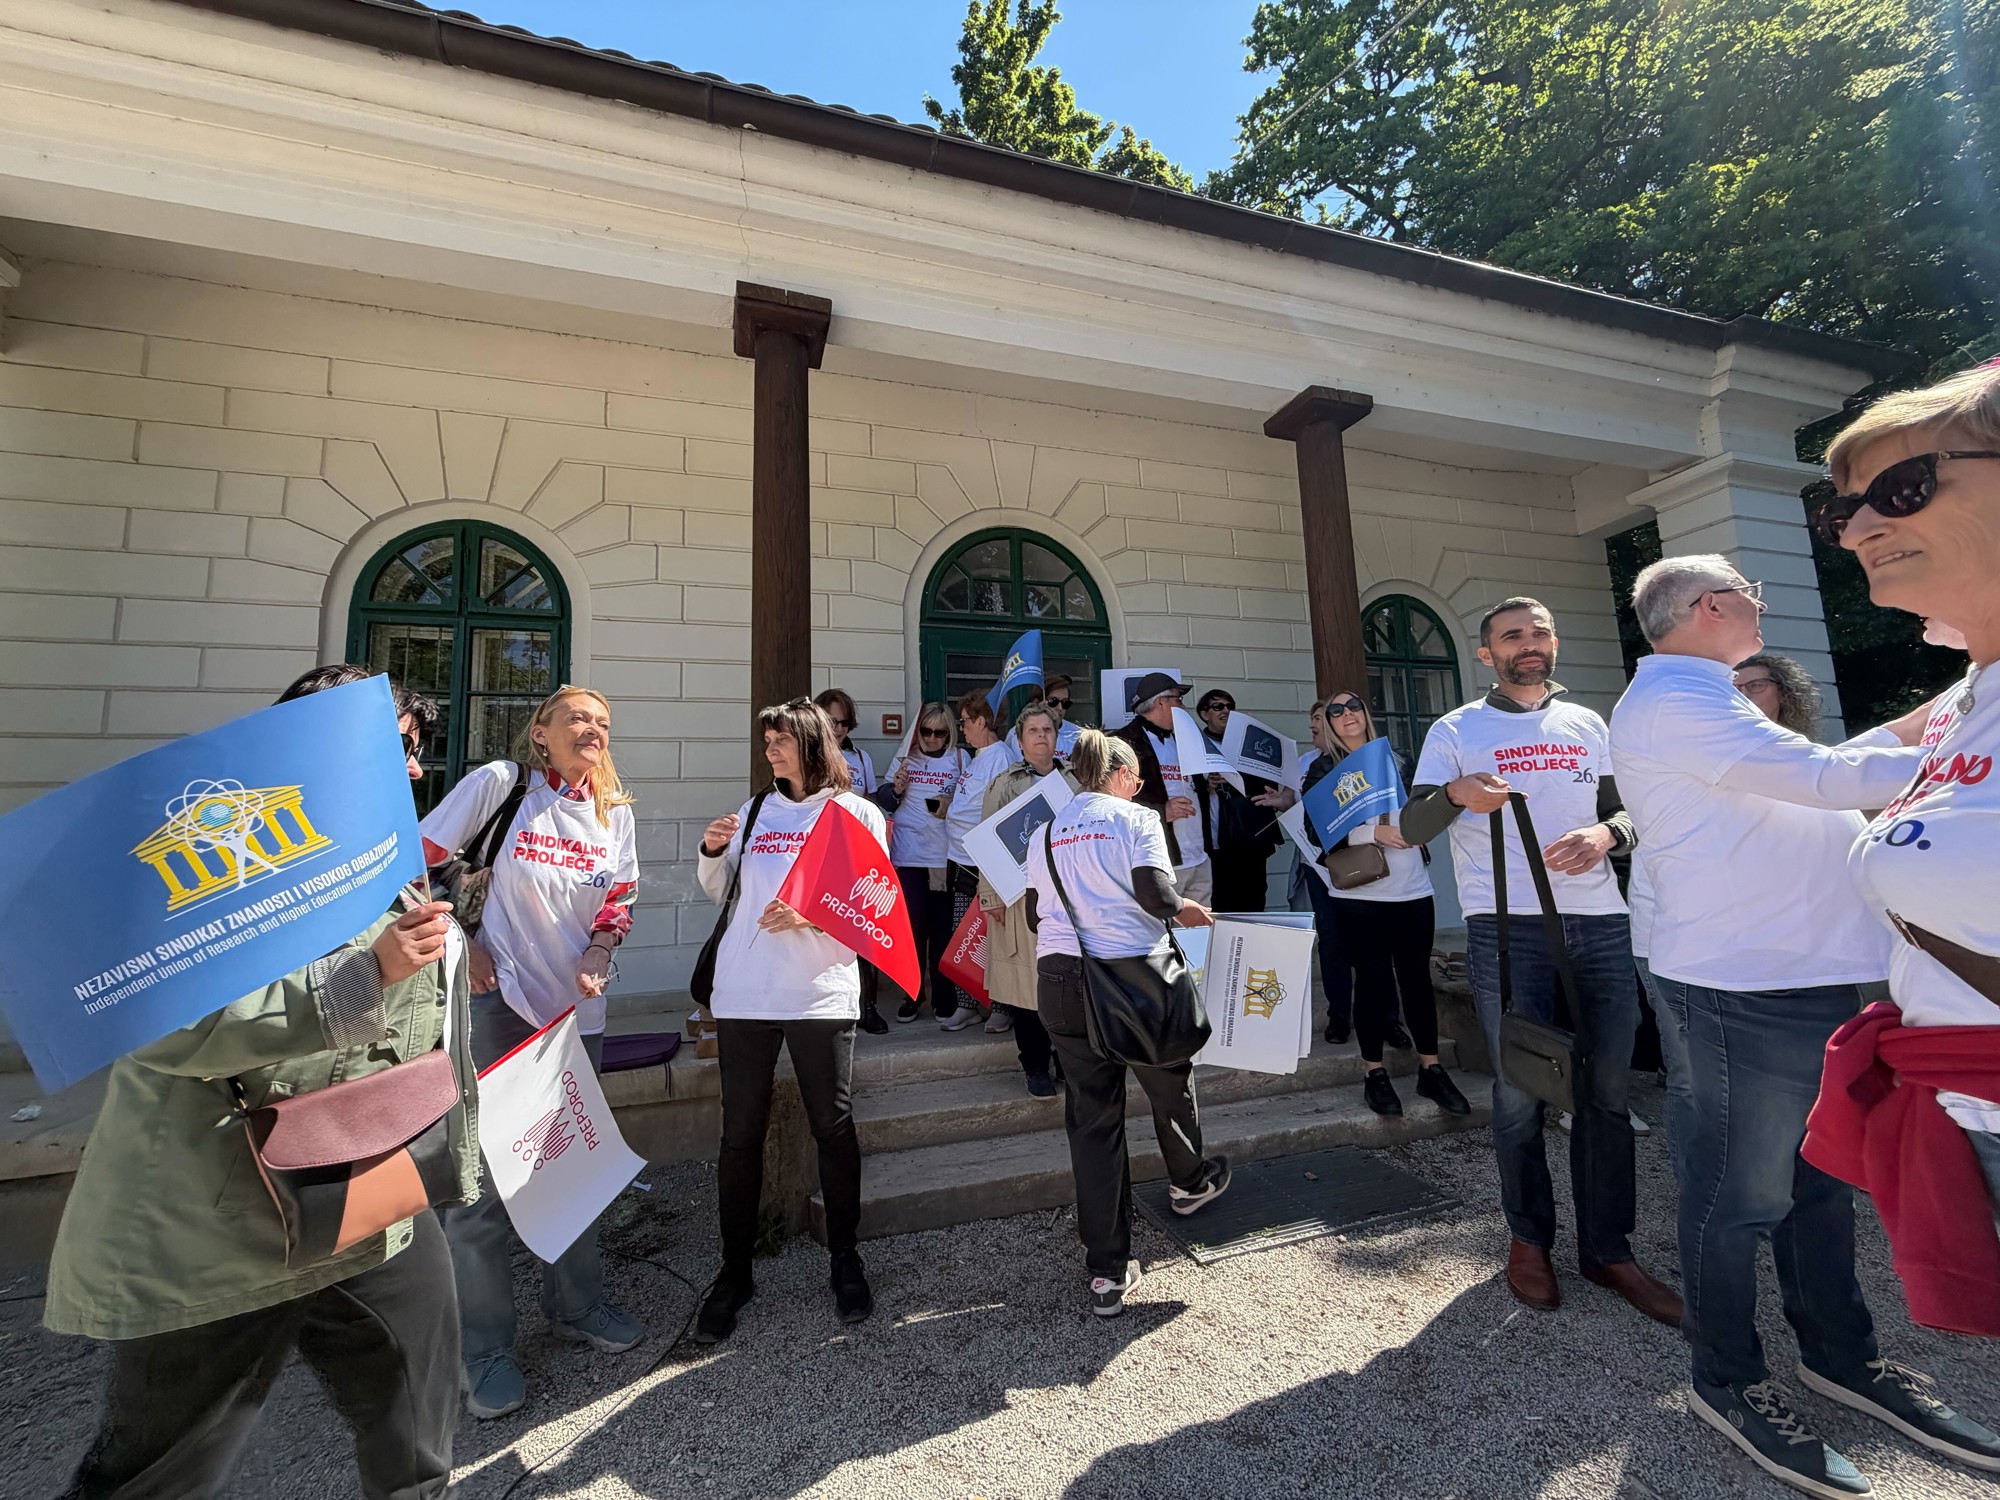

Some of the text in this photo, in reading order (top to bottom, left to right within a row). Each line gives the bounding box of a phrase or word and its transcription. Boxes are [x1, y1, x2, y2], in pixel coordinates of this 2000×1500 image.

[1494, 744, 1588, 761] SINDIKALNO
[1497, 755, 1579, 775] PROLJEĆE
[513, 846, 596, 872] PROLJEĆE
[516, 830, 607, 859] SINDIKALNO
[751, 843, 802, 855] PROLJE
[73, 951, 157, 1001] NEZAVISNI
[155, 919, 227, 961] SINDIKAT
[224, 889, 296, 930] ZNANOSTI
[292, 886, 303, 901] I
[299, 863, 353, 896] VISOKOG
[819, 892, 894, 949] PREPOROD
[84, 971, 160, 1015] Independent
[157, 956, 194, 979] Union
[192, 948, 206, 964] of
[205, 926, 260, 958] Research
[258, 916, 281, 934] and
[279, 901, 312, 925] Higher
[310, 882, 353, 909] Education
[953, 916, 983, 964] PREPOROD
[561, 1070, 600, 1151] PREPOROD
